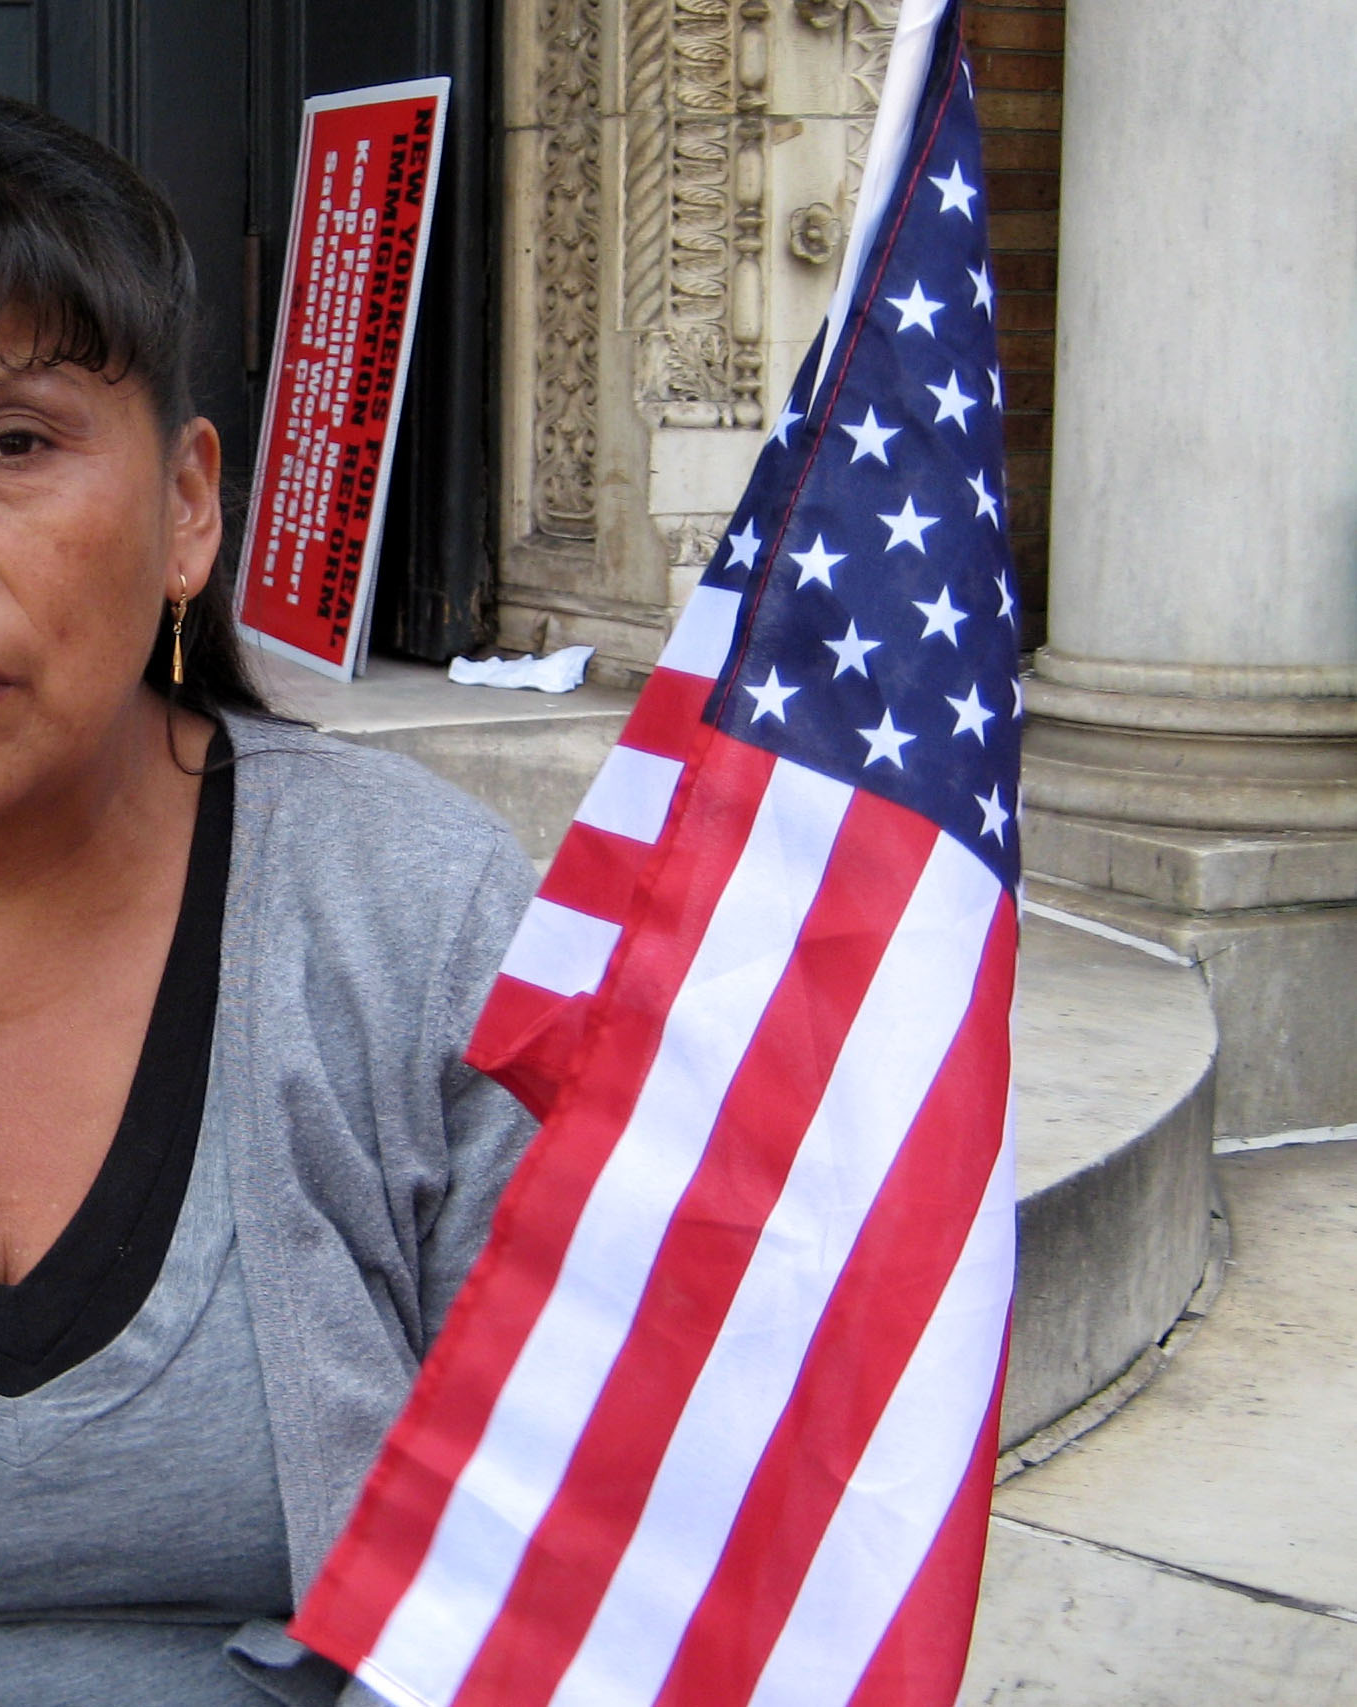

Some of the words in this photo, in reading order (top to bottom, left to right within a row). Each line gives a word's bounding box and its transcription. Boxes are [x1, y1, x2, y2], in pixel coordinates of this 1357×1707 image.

[345, 139, 371, 235] Keep
[404, 108, 433, 206] NEW
[300, 150, 339, 345] Safeguard
[313, 209, 345, 350] Protect
[331, 207, 377, 428] Citizenship
[351, 133, 398, 426] IMMIGRATION
[371, 222, 417, 421] YORKERS
[285, 358, 309, 441] Civil
[319, 249, 356, 413] Families
[261, 453, 294, 588] Rights!
[284, 360, 324, 533] Workers!
[286, 423, 328, 606] Together!
[312, 441, 341, 542] Now!
[353, 438, 381, 521] FOR
[317, 444, 360, 619] REFORM
[329, 538, 363, 648] REAL
